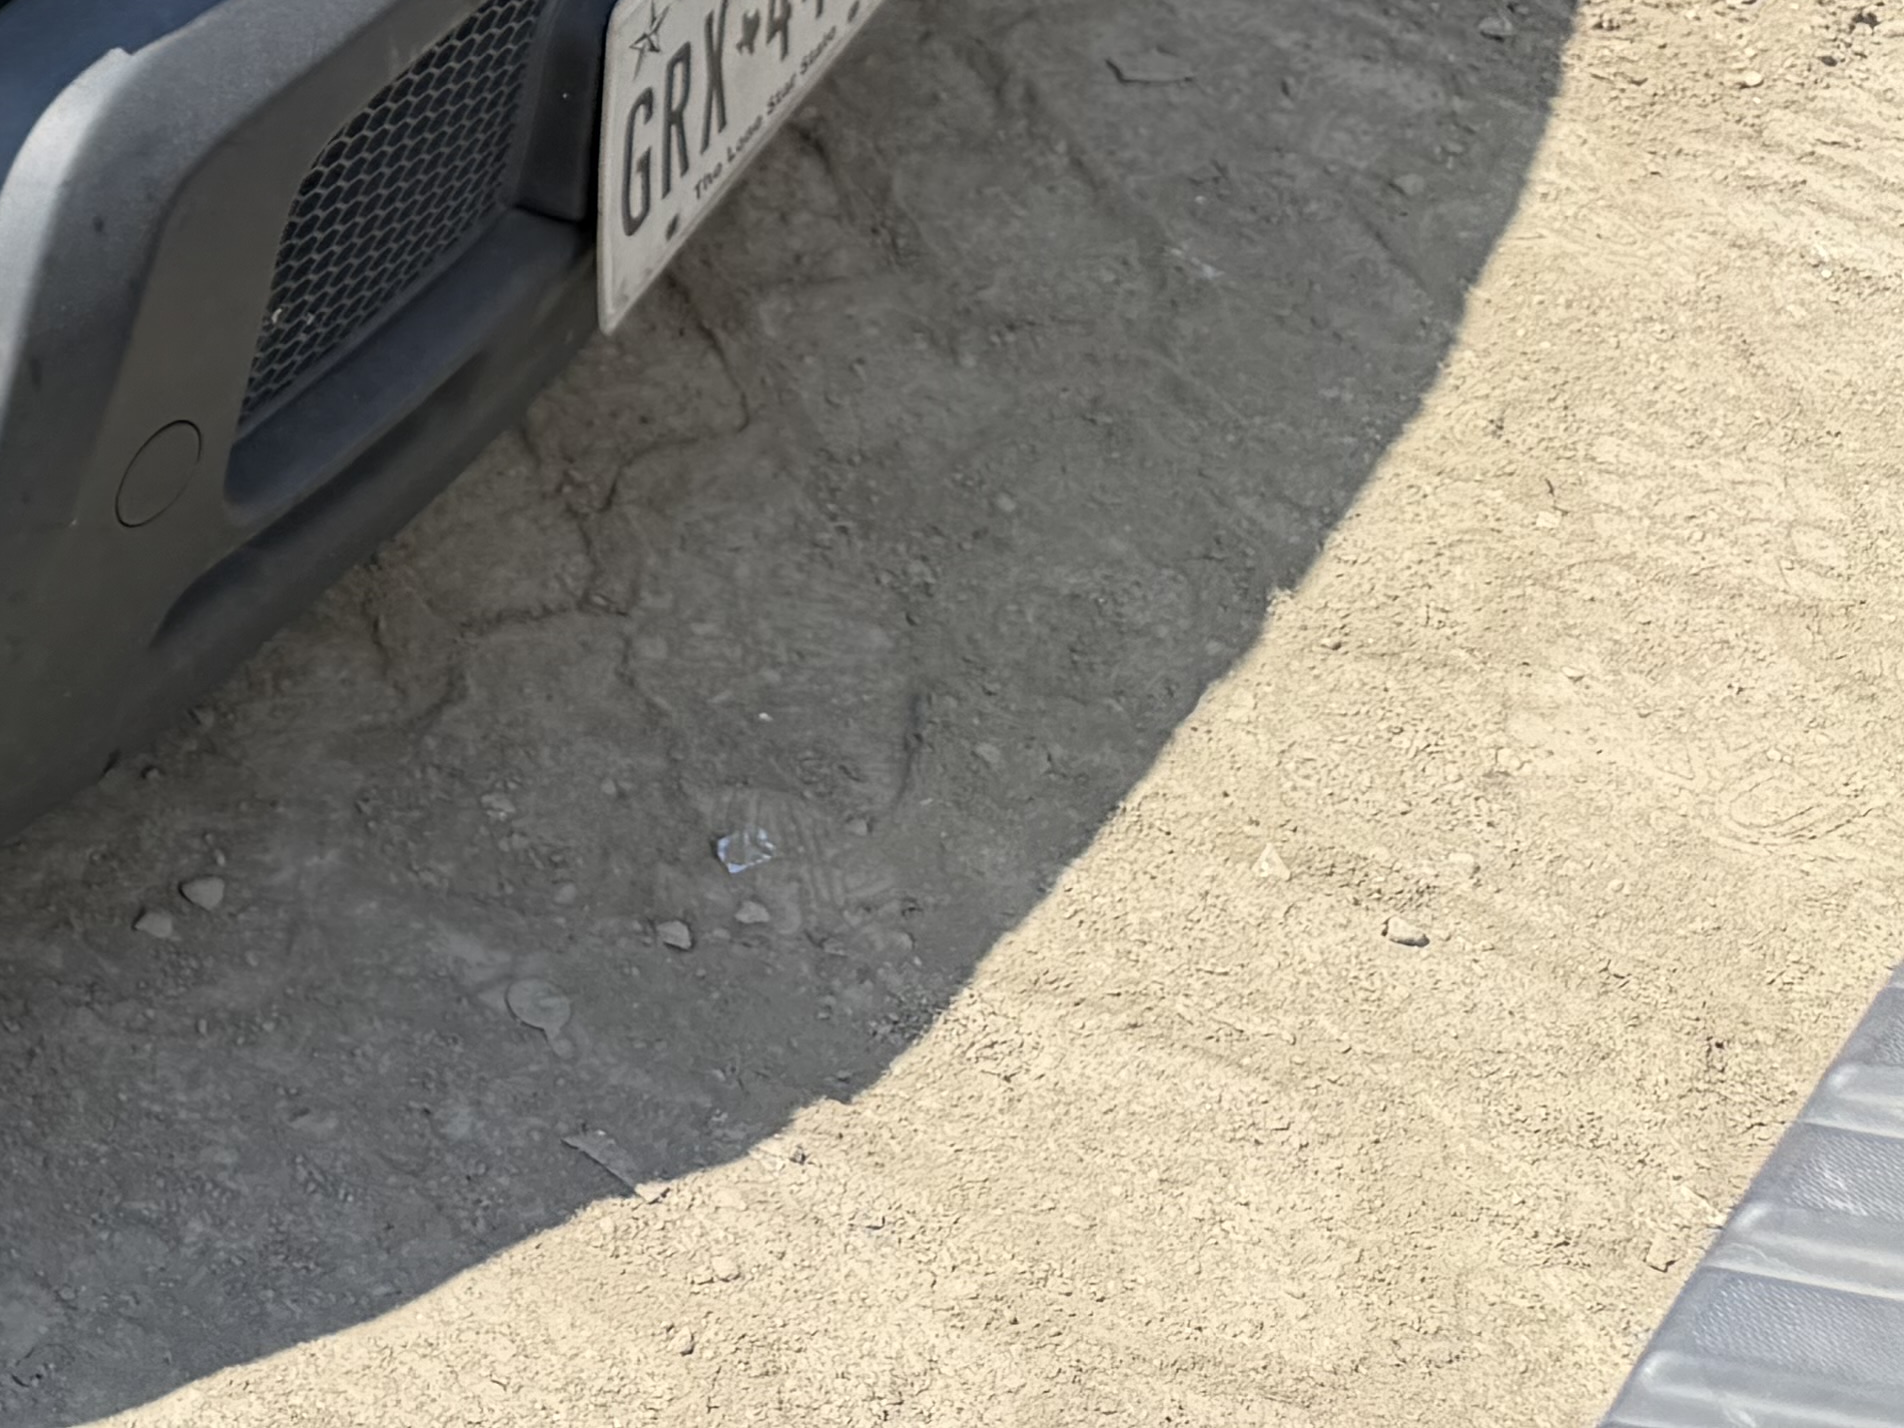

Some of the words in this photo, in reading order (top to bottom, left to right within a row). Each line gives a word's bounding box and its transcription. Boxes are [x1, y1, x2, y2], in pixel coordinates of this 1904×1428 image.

[694, 161, 723, 200] The
[727, 115, 763, 164] Lone
[766, 73, 797, 117] Star
[800, 25, 837, 76] State
